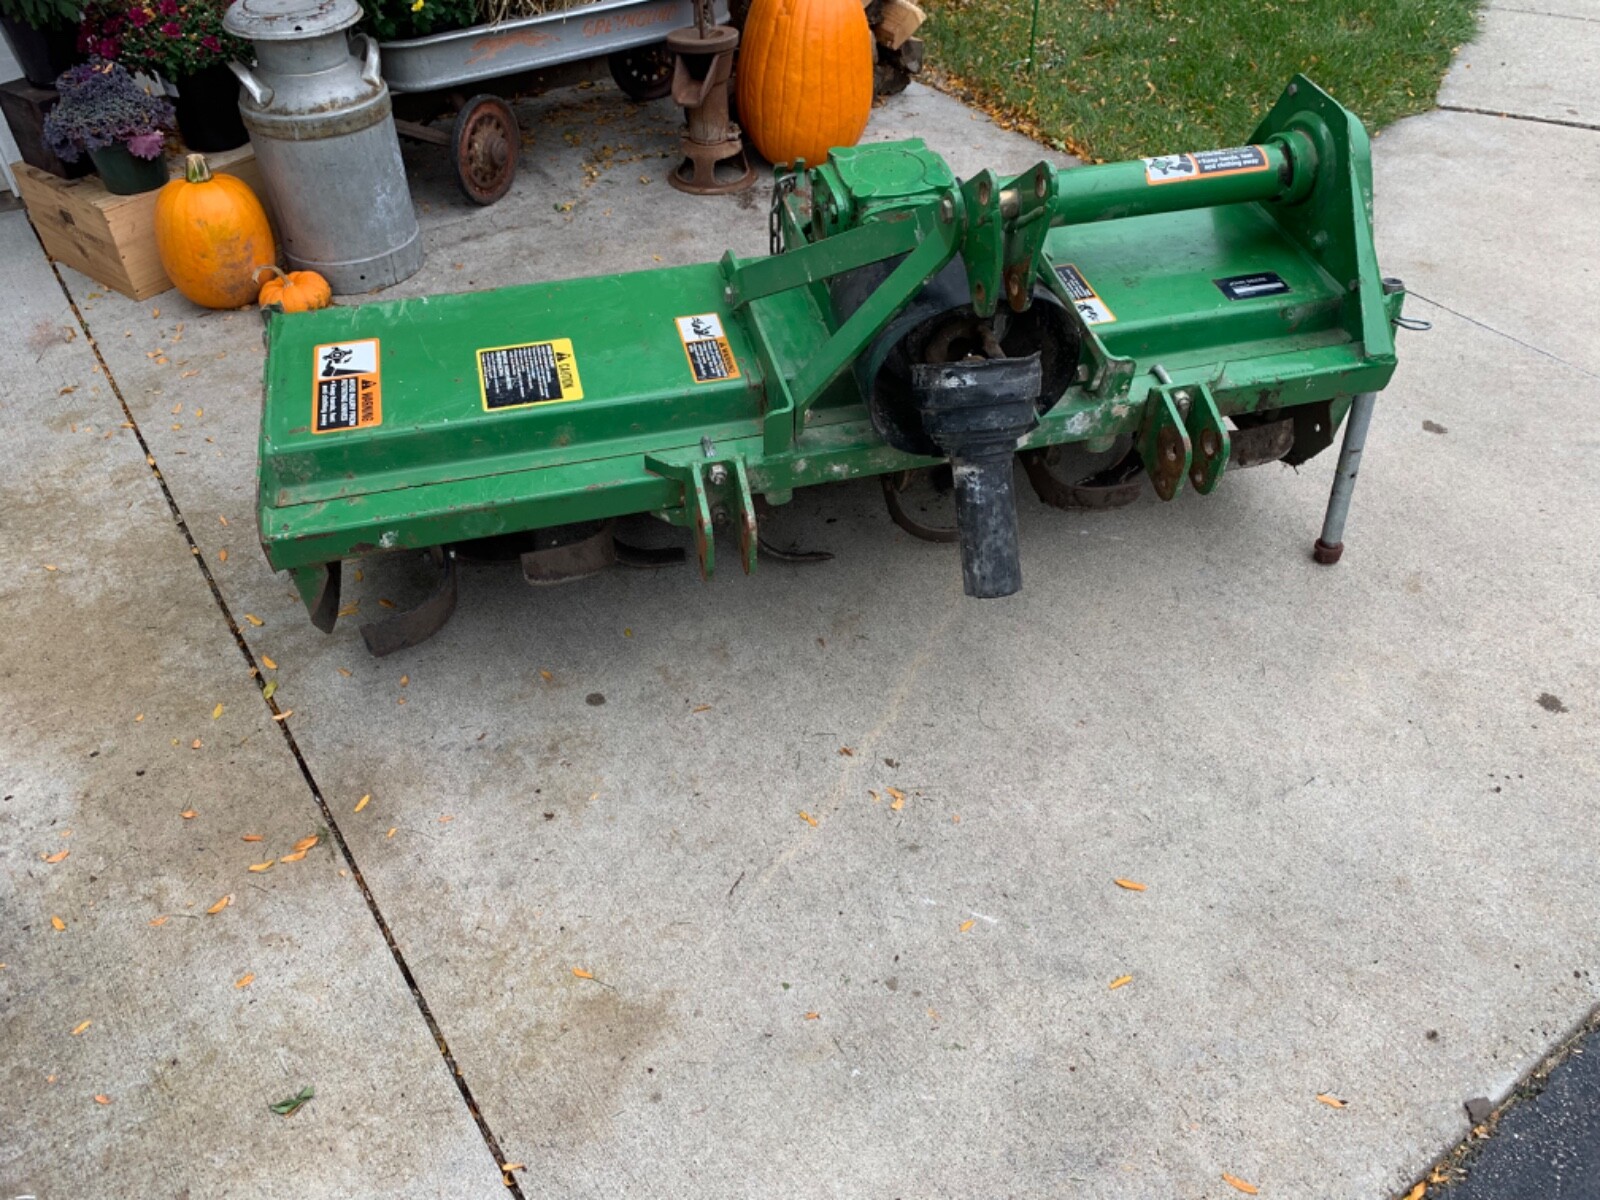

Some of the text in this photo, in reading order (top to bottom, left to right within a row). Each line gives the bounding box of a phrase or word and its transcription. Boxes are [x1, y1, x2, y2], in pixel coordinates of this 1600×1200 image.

[582, 4, 679, 38] GREYHOUND
[558, 363, 574, 388] CAUTION
[362, 392, 373, 421] WARNING
